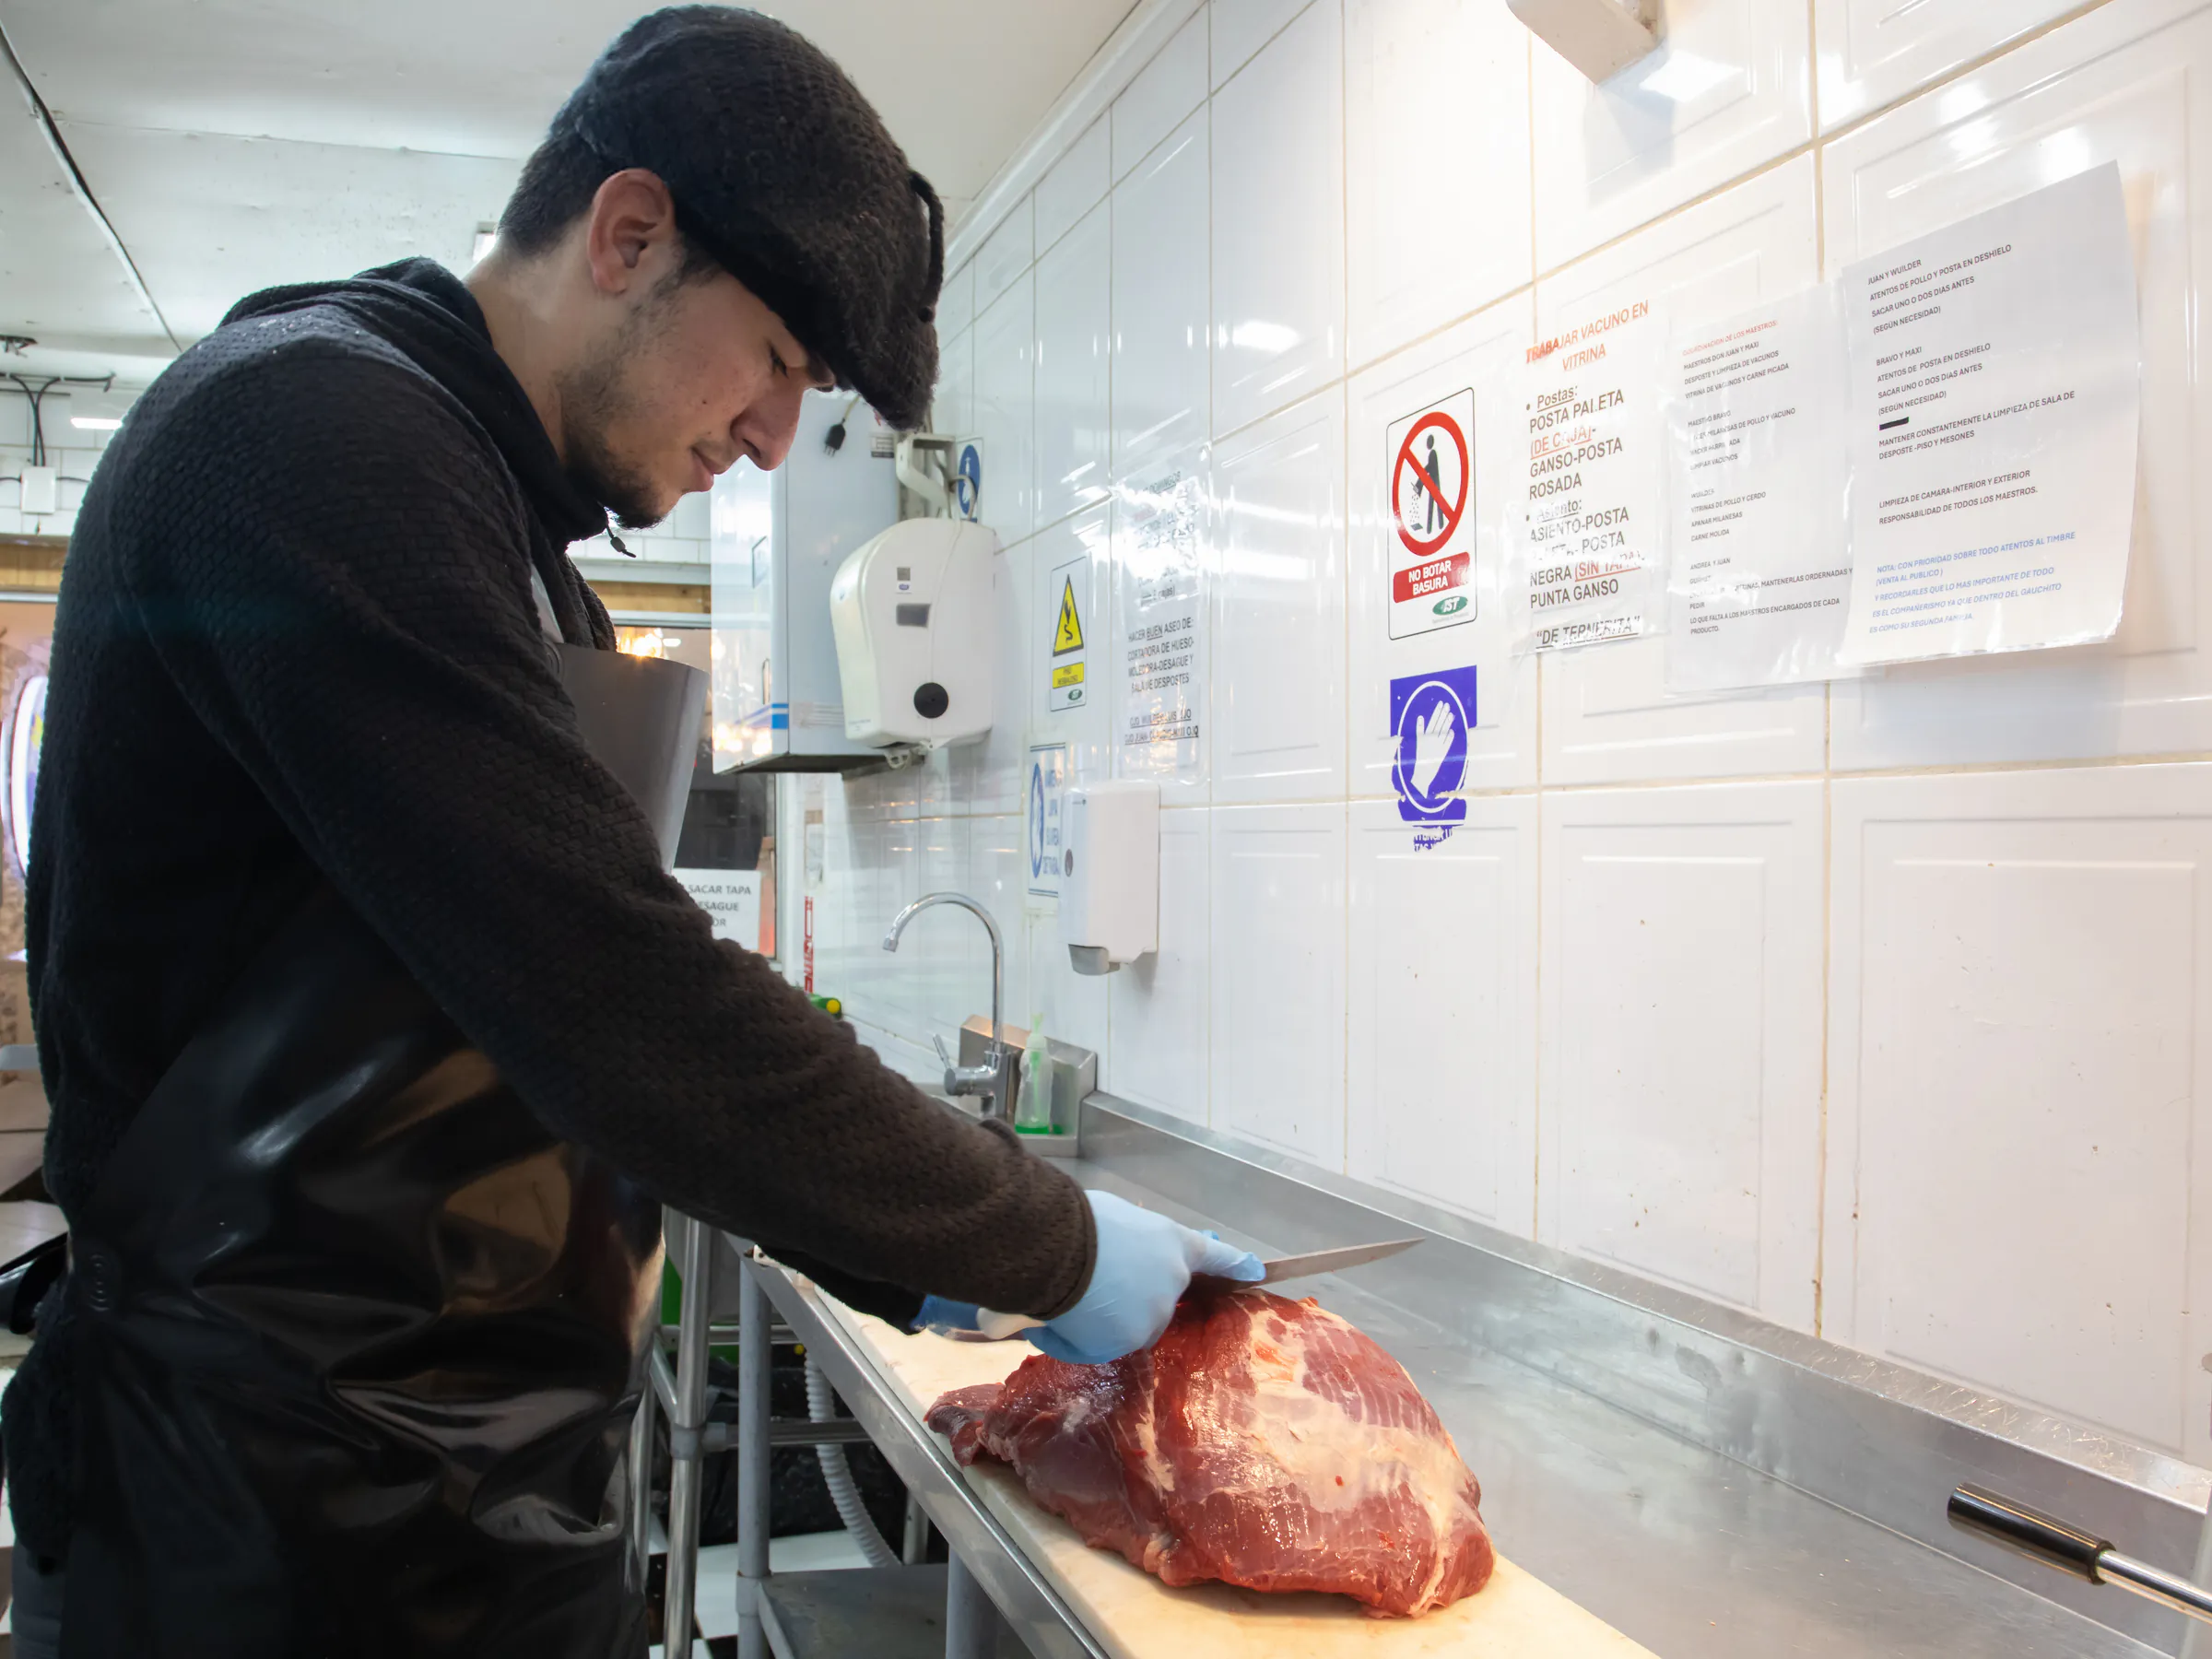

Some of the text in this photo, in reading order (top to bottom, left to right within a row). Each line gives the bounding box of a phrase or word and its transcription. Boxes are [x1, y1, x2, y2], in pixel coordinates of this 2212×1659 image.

[1868, 259, 1922, 285] JUAN Y WUILDER
[1870, 244, 2011, 301] ATENTOS DE POLLO Y POSTA EN DESHIELO
[1872, 276, 1974, 317] SACAR UNO DOS DIAS ANTES
[1900, 306, 1941, 326] NECESIDAD)
[1525, 300, 1648, 364] TRABAJAR VACUNO EN
[1734, 331, 1744, 339] LOS
[1562, 344, 1606, 371] VITRINA
[1684, 357, 1711, 371] MAESTROS
[1712, 352, 1724, 360] DON
[1725, 347, 1739, 358] JUAN
[1745, 341, 1759, 351] MAXI
[1685, 371, 1712, 384] DESPOSTE
[1716, 362, 1741, 375] LIMPIEZA
[1750, 350, 1779, 364] VACUNOS
[1877, 347, 1922, 366] BRAVO Y MAXI
[1877, 343, 1990, 382] ATENTOS DE POSTA EN DESHIELO
[1707, 385, 1713, 394] DE
[1747, 370, 1766, 381] CARNE
[1767, 363, 1789, 374] PICADA
[1878, 363, 1982, 398] SACAR UNO DOS DIAS ANTES
[1537, 385, 1578, 408] Postas:
[1904, 390, 1947, 408] NECESIDAD)
[1530, 389, 1624, 433] POSTA PALETA
[1747, 416, 1764, 427] POLLO
[1879, 391, 2075, 447] MANTENER CONSTANTEMENTE LA LIMPIEZA DE SALA DE
[1531, 436, 1548, 458] (DE
[1879, 445, 1912, 459] DESPOSTE
[1940, 430, 1974, 445] MESONES
[1530, 437, 1622, 477] GANSO-POSTA
[1530, 473, 1582, 500] ROSADA
[1879, 470, 2030, 509] LIMPIEZA DE CAMARA-INTERIOR Y EXTERIOR
[1724, 498, 1740, 506] POLLO
[1747, 492, 1766, 501] CERDO
[1879, 486, 2038, 524] RESPONSABILIDAD DE TODOS LOS MAESTROS.
[1531, 507, 1629, 542] ASIENTO-POSTA
[1691, 512, 1742, 527] APANAR MILANESAS
[1583, 531, 1625, 553] POSTA
[1691, 529, 1729, 542] CARNE MOLIDA
[1877, 531, 2076, 573] NOTA: CON PRIORIDAD SOBRE TODO ATENTOS AL TIMBRE
[1408, 560, 1452, 582] NO BOTAR
[1530, 565, 1571, 587] NEGRA
[1575, 560, 1599, 578] (SIN
[1761, 568, 1848, 588] MANTENERLAS ORDERNADAS
[1877, 570, 1939, 587] (VENTA AL PUBLICO
[1413, 575, 1448, 595] BASURA
[1531, 579, 1618, 608] PUNTA GANSO
[1880, 586, 1928, 601] RECORDARLES
[1929, 584, 1944, 594] QUE
[1946, 582, 1954, 591] LO
[1956, 580, 1971, 590] MAS
[1973, 572, 2018, 588] IMPORTANTE
[2020, 570, 2030, 579] DE
[2032, 567, 2053, 576] TODO
[1947, 599, 1955, 607] YA
[1957, 597, 1971, 606] QUE
[1973, 592, 2003, 604] DENTRO
[2006, 590, 2018, 599] DEL
[2020, 582, 2061, 597] GAUCHITO
[1442, 597, 1460, 612] IST
[1689, 602, 1704, 610] PEDIR
[1710, 613, 1724, 621] FALTA
[1729, 610, 1739, 618] LOS
[1771, 602, 1812, 614] ENCARGADOS
[1147, 625, 1162, 638] BUEN
[1164, 620, 1180, 633] ASEO
[1878, 622, 1899, 632] COMO
[1900, 620, 1909, 629] SU
[1911, 617, 1943, 629] SEGUNDA
[1161, 641, 1170, 653] DE
[688, 885, 751, 895] SACAR TAPA
[712, 917, 726, 926] OR
